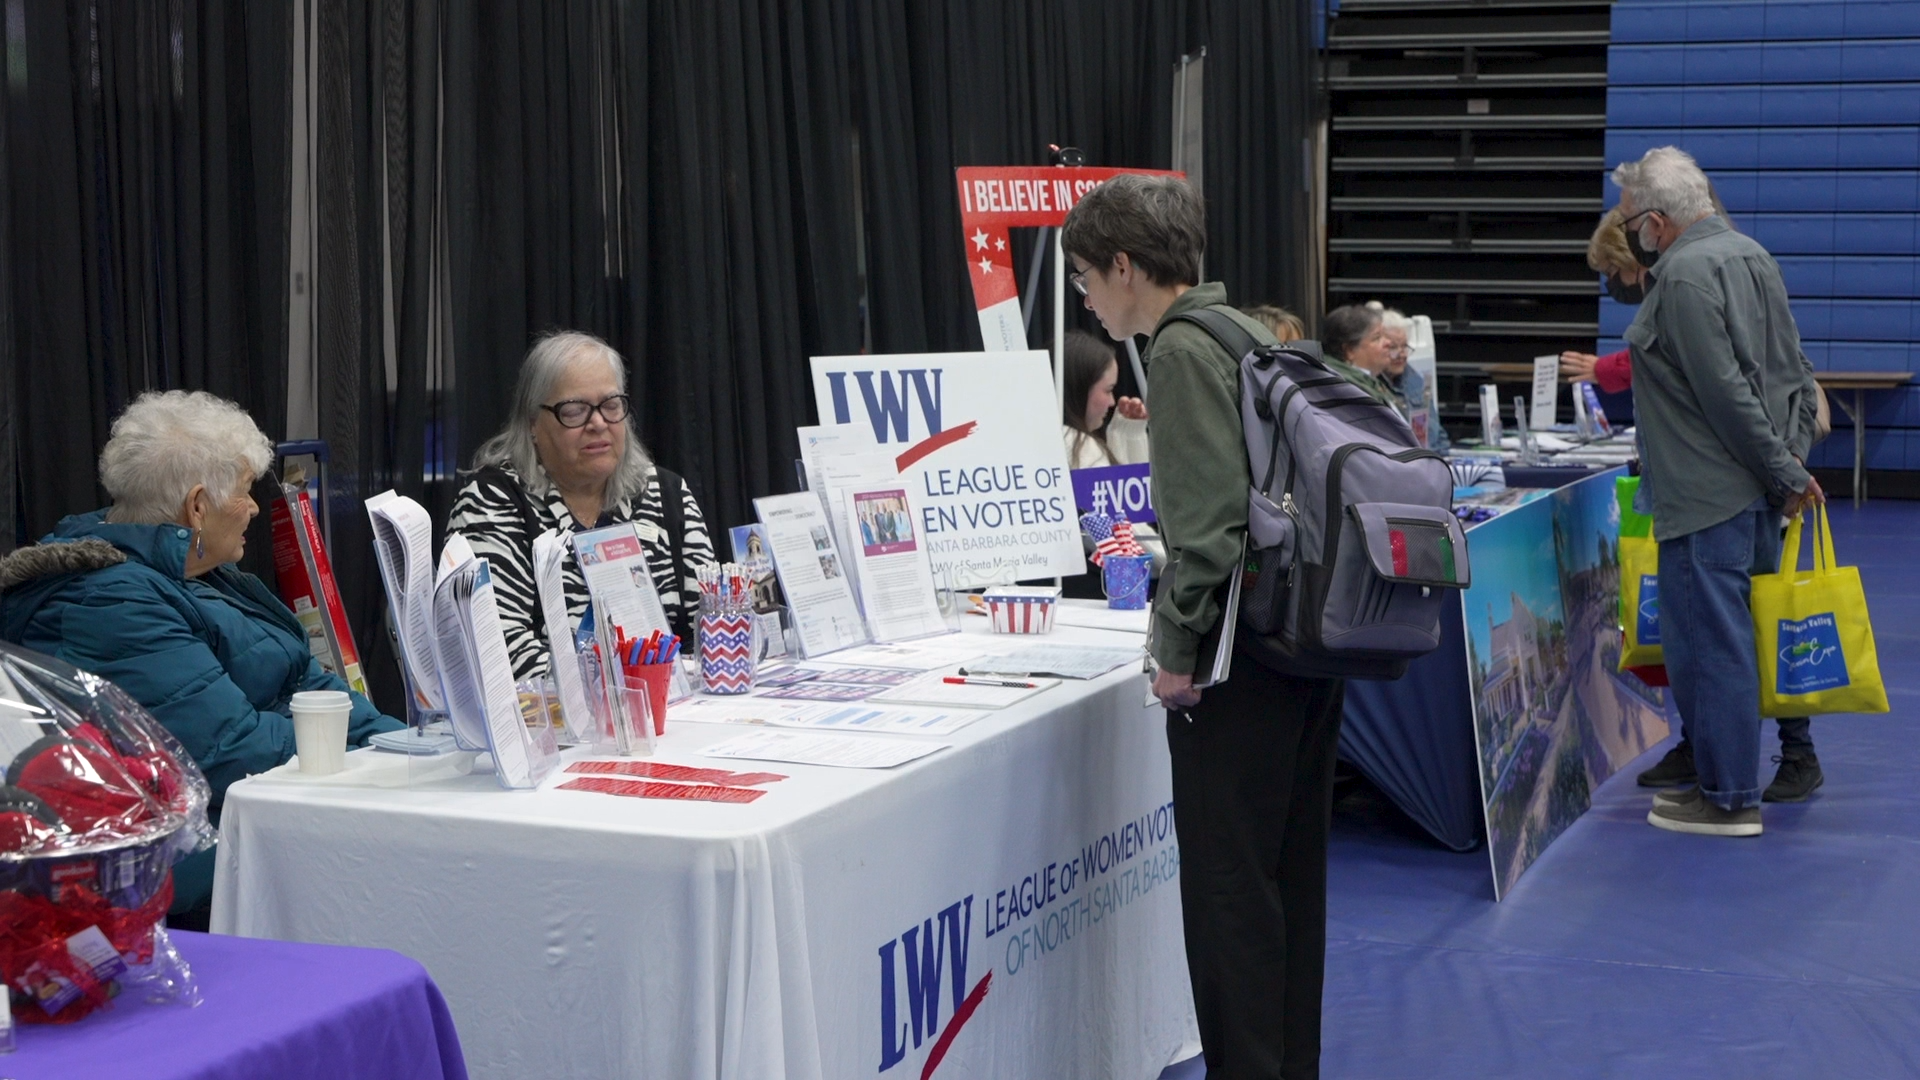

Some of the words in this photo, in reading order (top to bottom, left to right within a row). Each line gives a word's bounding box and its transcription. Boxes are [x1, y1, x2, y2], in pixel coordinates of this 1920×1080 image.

[963, 180, 972, 213] I
[974, 179, 1052, 213] BELIEVE
[1053, 179, 1074, 212] IN
[924, 464, 1028, 498] LEAGUE
[1035, 467, 1062, 489] OF
[1092, 476, 1153, 515] #VOT
[923, 505, 958, 533] EN
[928, 540, 960, 554] ANTA
[963, 534, 1018, 552] BARBARA
[1021, 529, 1072, 546] COUNTY
[966, 559, 992, 571] Santa
[1022, 553, 1049, 567] Valley
[1808, 616, 1833, 627] Valley
[985, 862, 1057, 939] LEAGUE
[1060, 857, 1080, 895] OF
[1082, 816, 1146, 879] WOMEN
[1146, 801, 1176, 846] VOT
[1005, 928, 1032, 977] OF
[1032, 896, 1092, 962] NORTH
[1093, 870, 1142, 923] SANTA
[878, 894, 974, 1074] LWV
